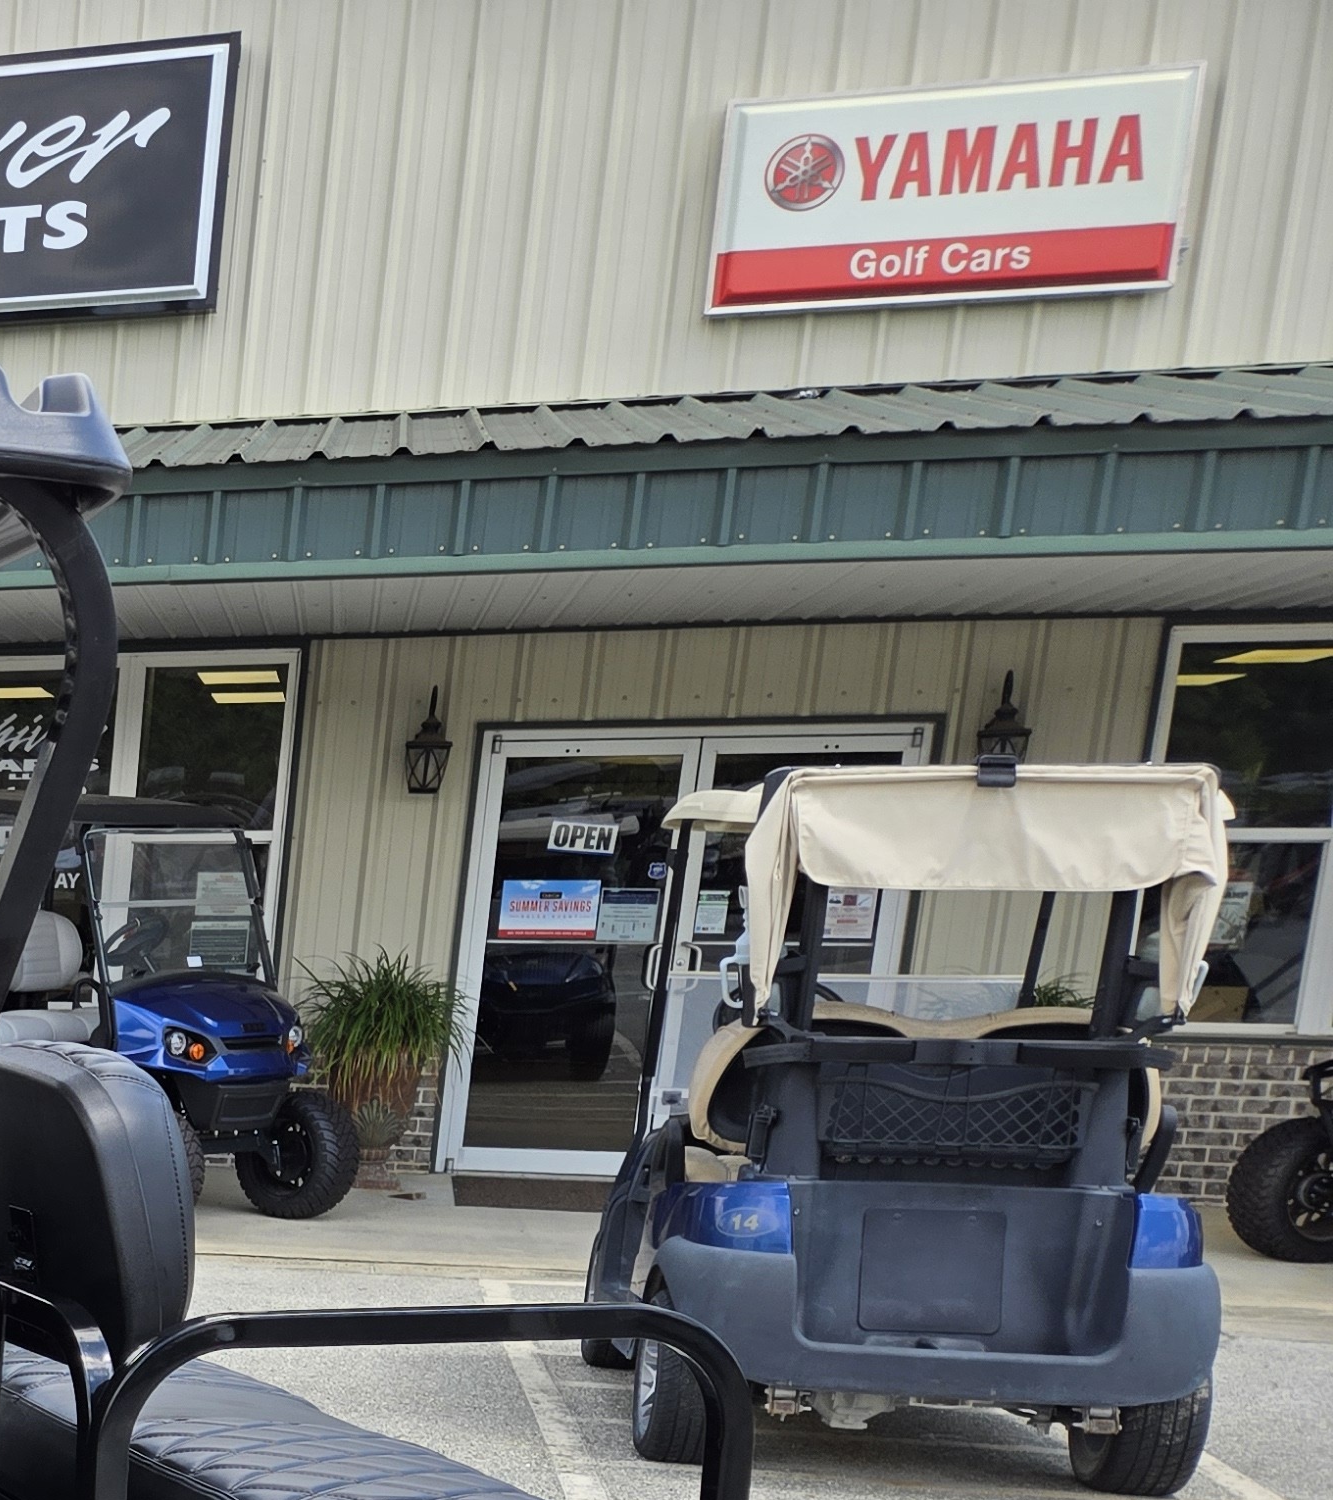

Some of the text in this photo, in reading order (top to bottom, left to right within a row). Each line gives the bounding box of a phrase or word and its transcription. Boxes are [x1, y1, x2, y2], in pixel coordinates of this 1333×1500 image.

[854, 113, 1144, 202] YAMAHA
[849, 242, 1032, 280] Golf Cars
[553, 824, 614, 851] OPEN
[509, 900, 592, 913] SUMMER SAVINGS
[733, 1213, 759, 1231] 14
